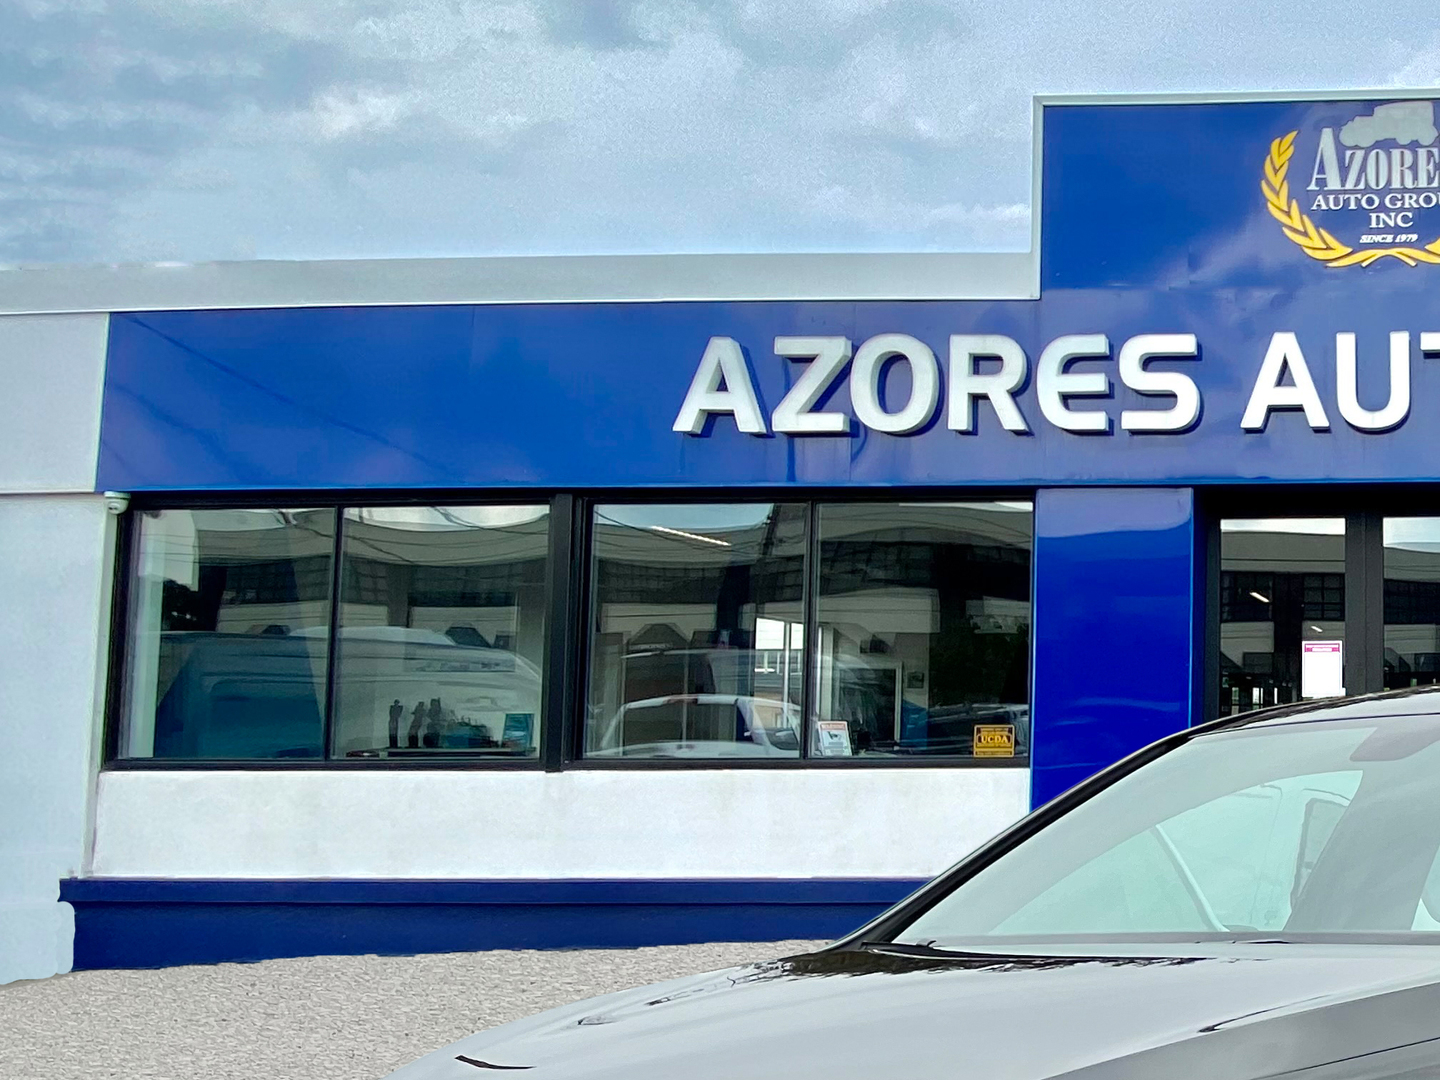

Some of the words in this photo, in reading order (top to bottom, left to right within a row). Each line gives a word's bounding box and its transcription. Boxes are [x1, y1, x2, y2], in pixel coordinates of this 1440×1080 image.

[1311, 193, 1379, 211] AUTO
[1369, 211, 1413, 228] INC
[1360, 234, 1393, 244] SINCE
[1395, 233, 1418, 243] 1979
[672, 332, 1201, 436] AZORES
[981, 735, 1009, 744] UCDA
